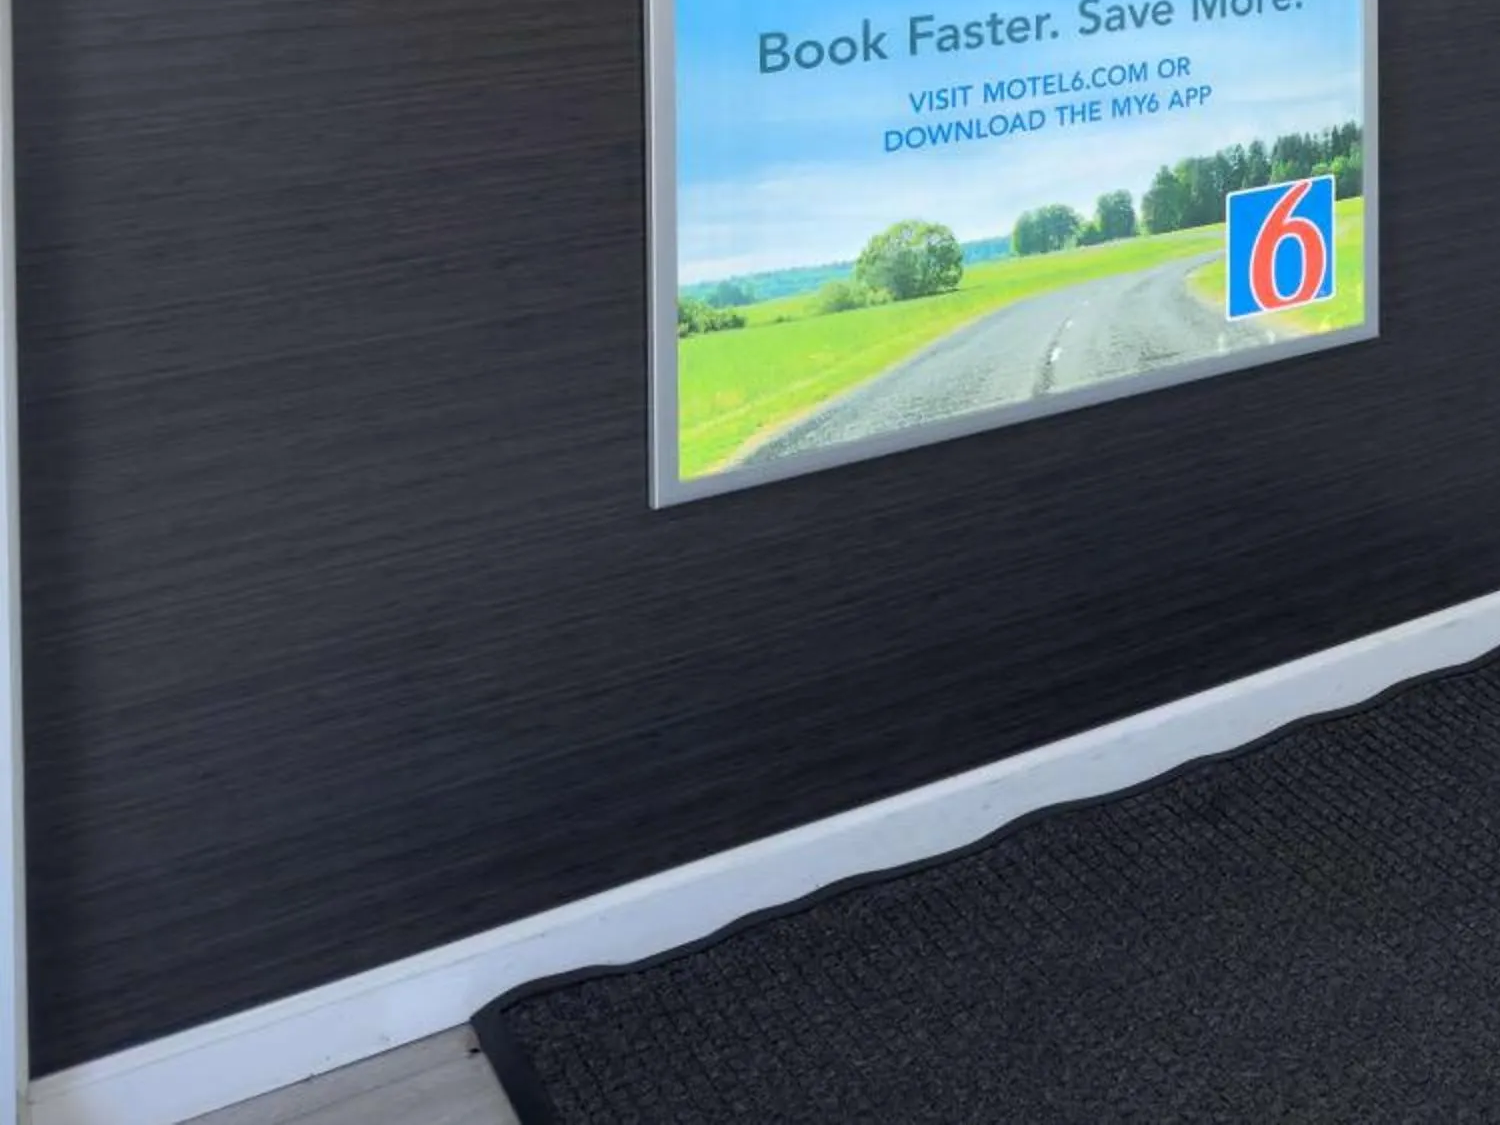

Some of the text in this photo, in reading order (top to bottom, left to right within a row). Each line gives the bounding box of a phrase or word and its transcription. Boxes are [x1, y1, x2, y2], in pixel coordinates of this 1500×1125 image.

[758, 18, 888, 75] Book
[908, 14, 1060, 56] Faster.
[909, 56, 1192, 114] VISIT MOTEL6.COM OR
[884, 84, 1213, 153] DOWNLOAD THE MY6 APP
[1249, 178, 1327, 312] 6
